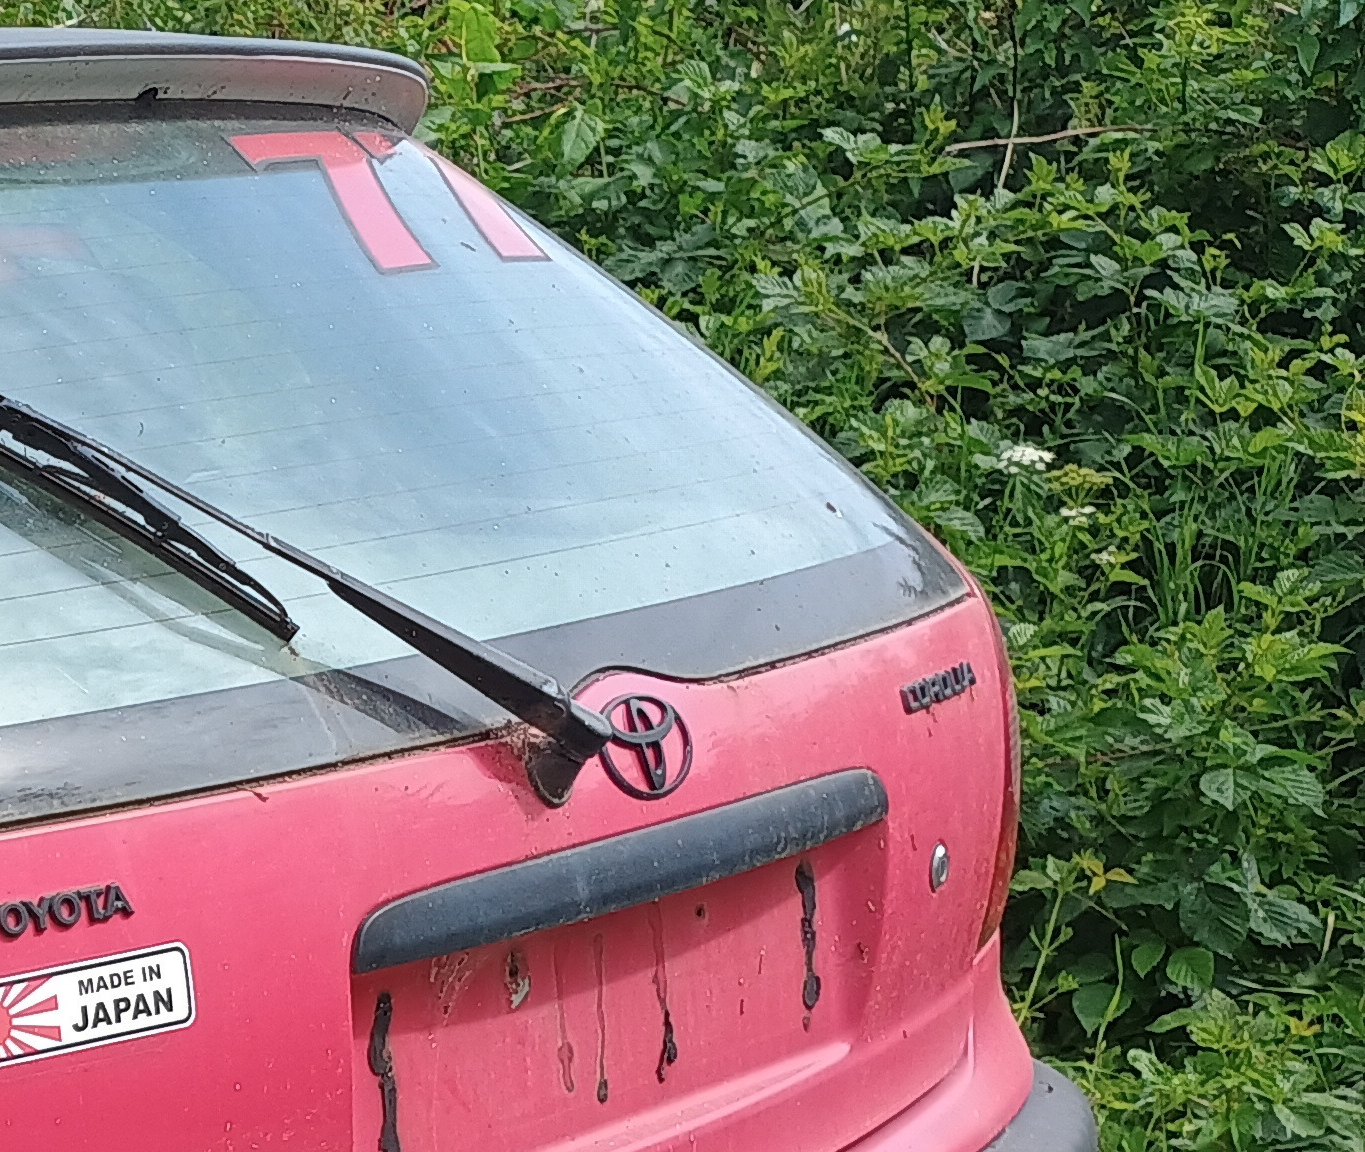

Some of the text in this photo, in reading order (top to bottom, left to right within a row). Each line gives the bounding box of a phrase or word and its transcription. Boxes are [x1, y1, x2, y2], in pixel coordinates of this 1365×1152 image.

[77, 963, 163, 996] MADE IN
[72, 987, 174, 1033] JAPAN
